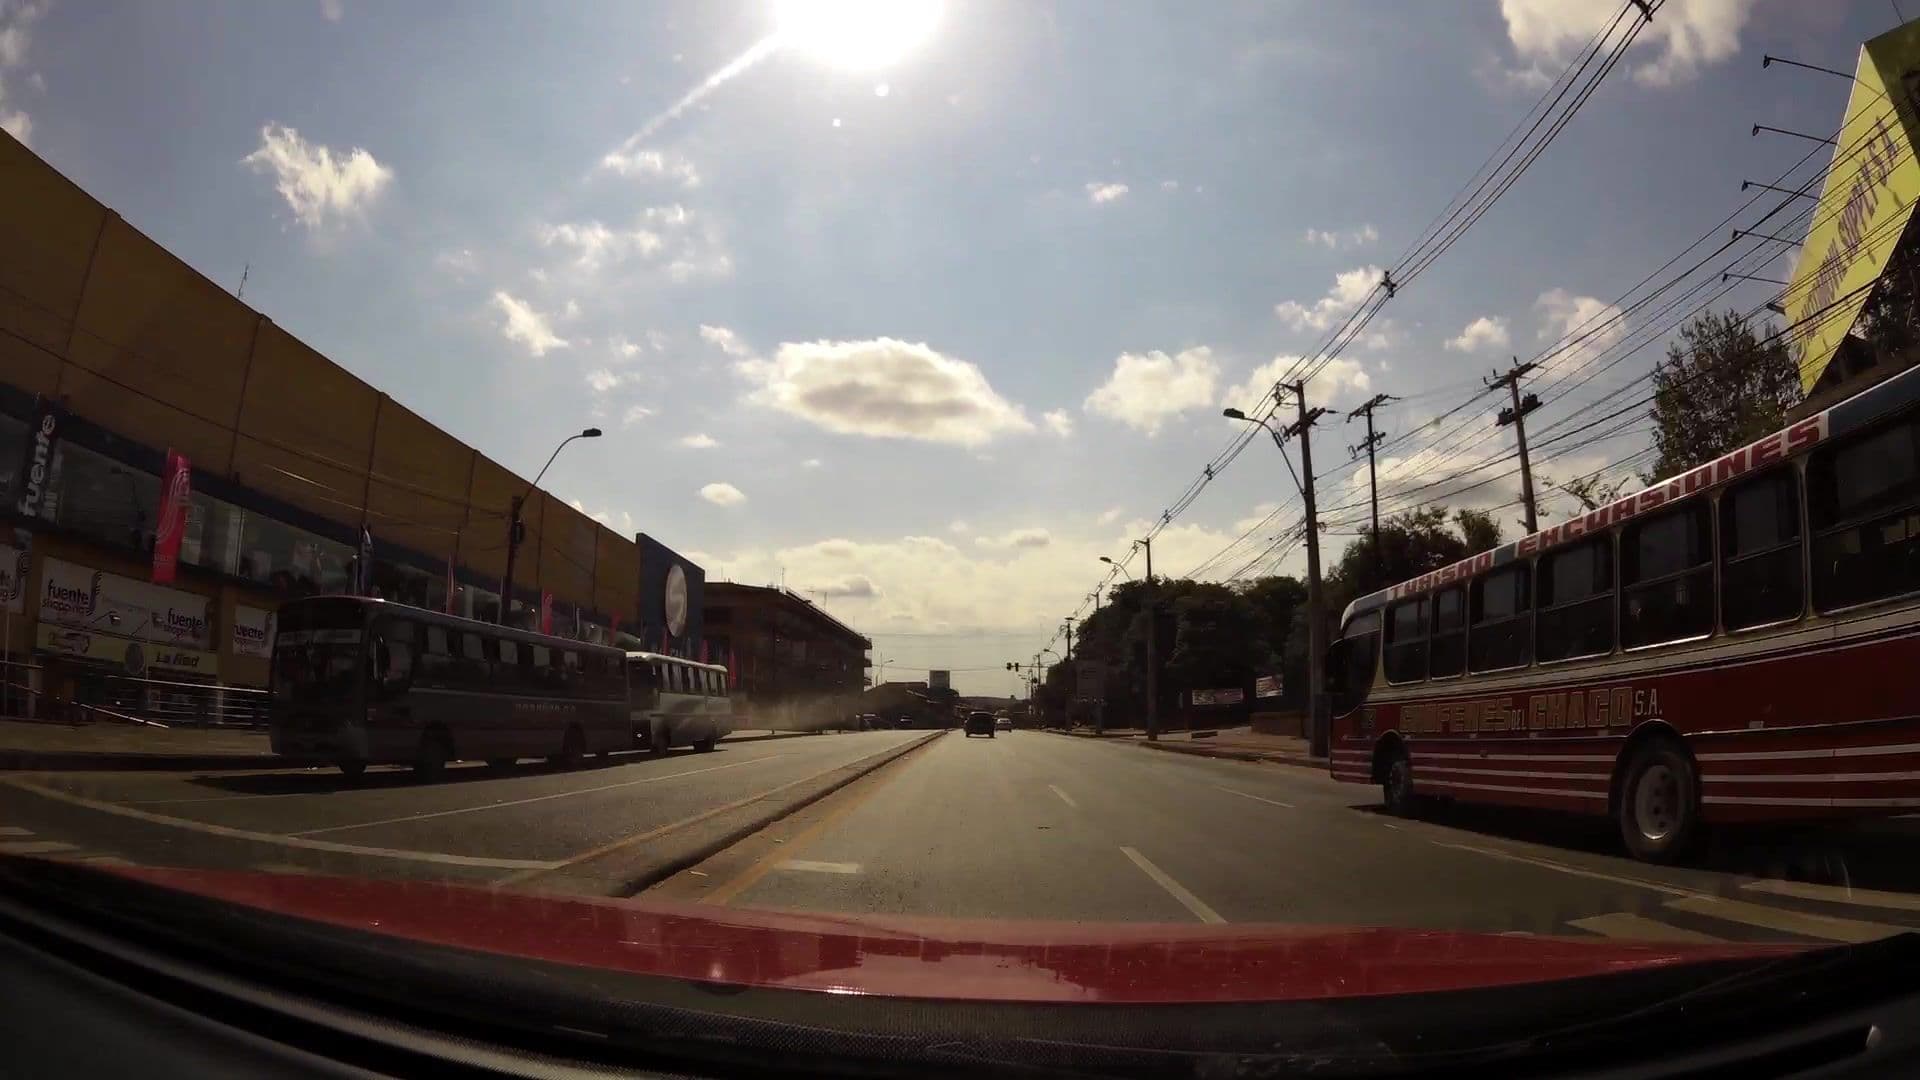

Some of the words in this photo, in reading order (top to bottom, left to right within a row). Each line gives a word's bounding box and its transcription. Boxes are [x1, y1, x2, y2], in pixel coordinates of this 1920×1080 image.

[17, 414, 56, 517] fuente
[1391, 552, 1492, 599] TURISMO
[1518, 414, 1820, 556] EXCURSIONES
[48, 579, 89, 605] fuente
[167, 607, 203, 629] fuente
[1512, 708, 1527, 731] DEL
[1528, 686, 1633, 730] CHACO
[1634, 687, 1663, 716] S.A.
